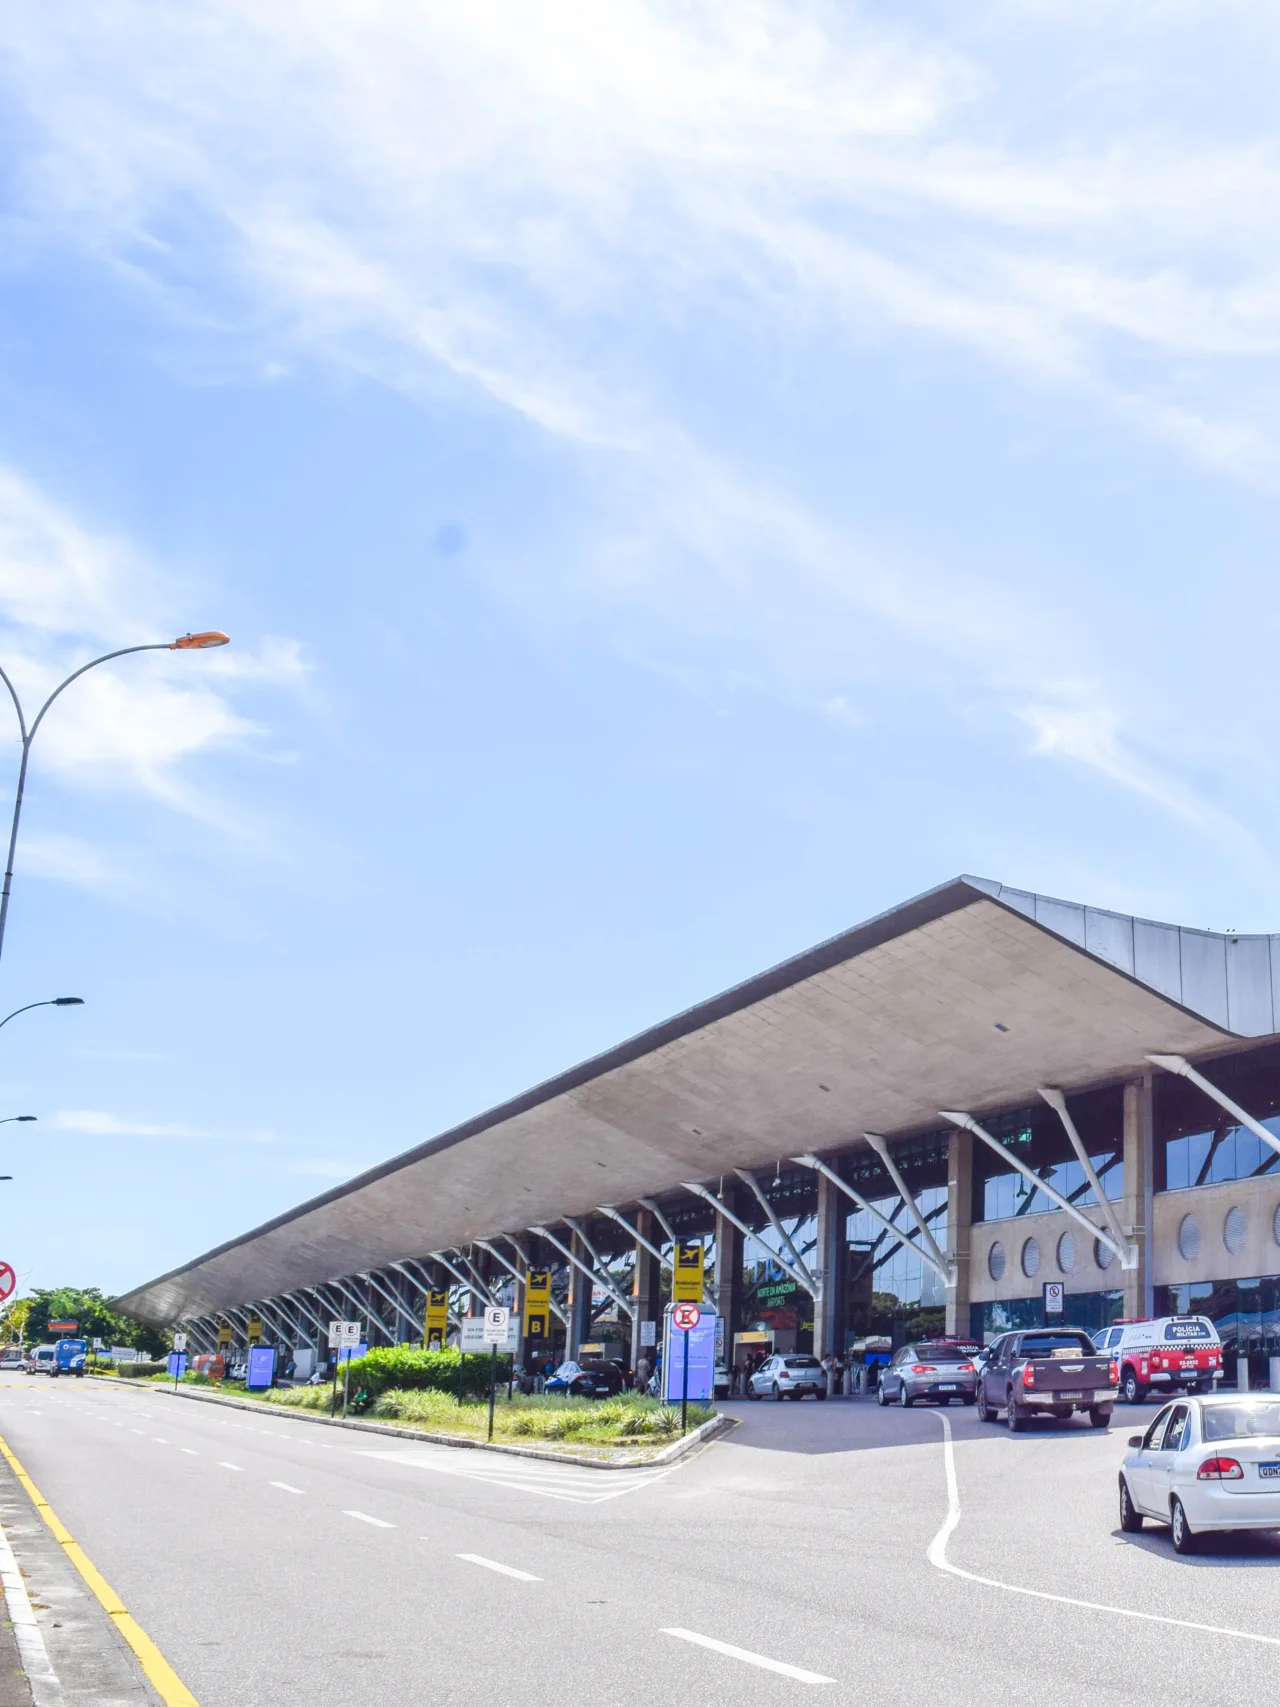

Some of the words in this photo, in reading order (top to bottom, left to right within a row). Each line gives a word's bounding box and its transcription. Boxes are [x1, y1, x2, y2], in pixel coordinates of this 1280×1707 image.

[493, 1313, 500, 1322] E
[532, 1321, 541, 1333] B
[1172, 1325, 1200, 1333] POLÍCIA
[431, 1333, 439, 1342] C
